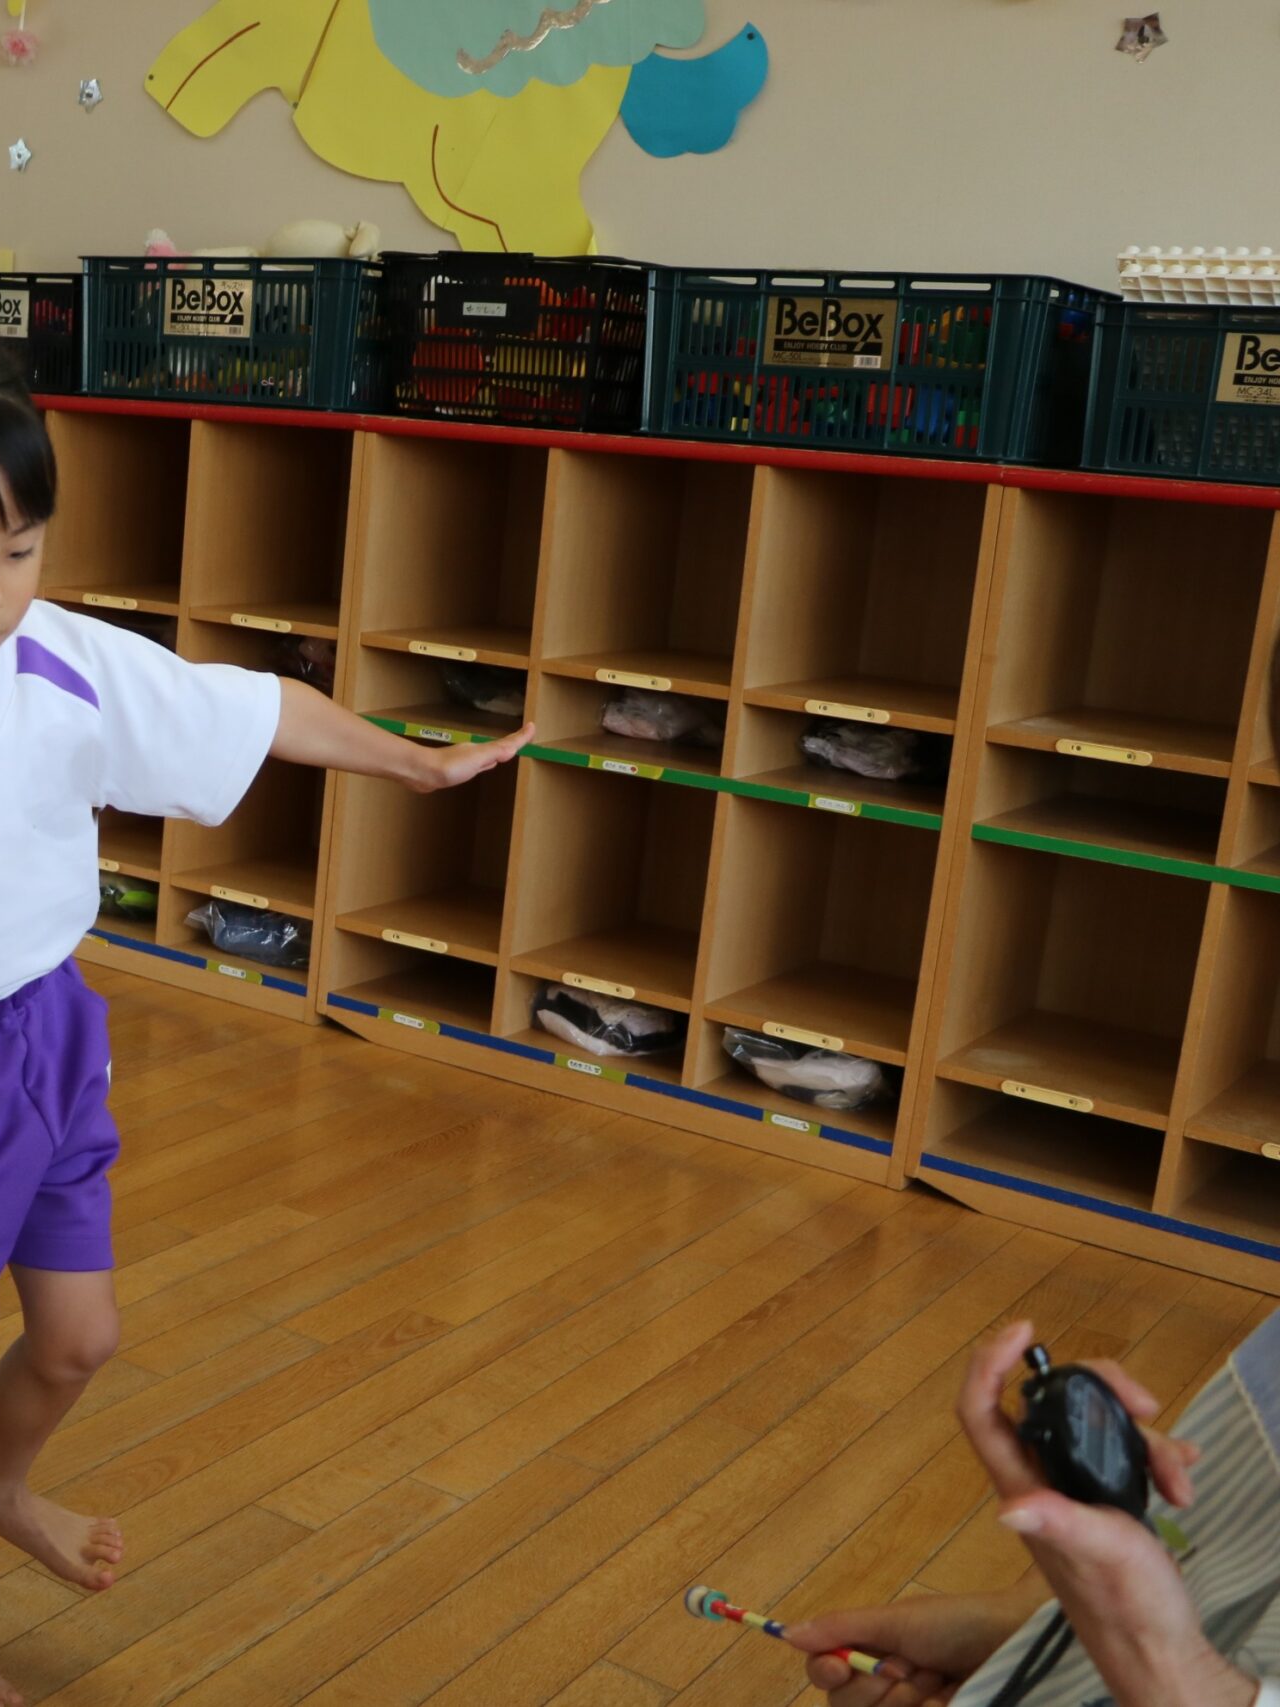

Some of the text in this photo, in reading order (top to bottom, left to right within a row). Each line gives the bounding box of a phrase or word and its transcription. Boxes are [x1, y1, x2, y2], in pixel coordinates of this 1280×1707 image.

[171, 279, 244, 315] BeBox
[775, 297, 884, 343] BeBox
[1243, 376, 1267, 384] ENJOY
